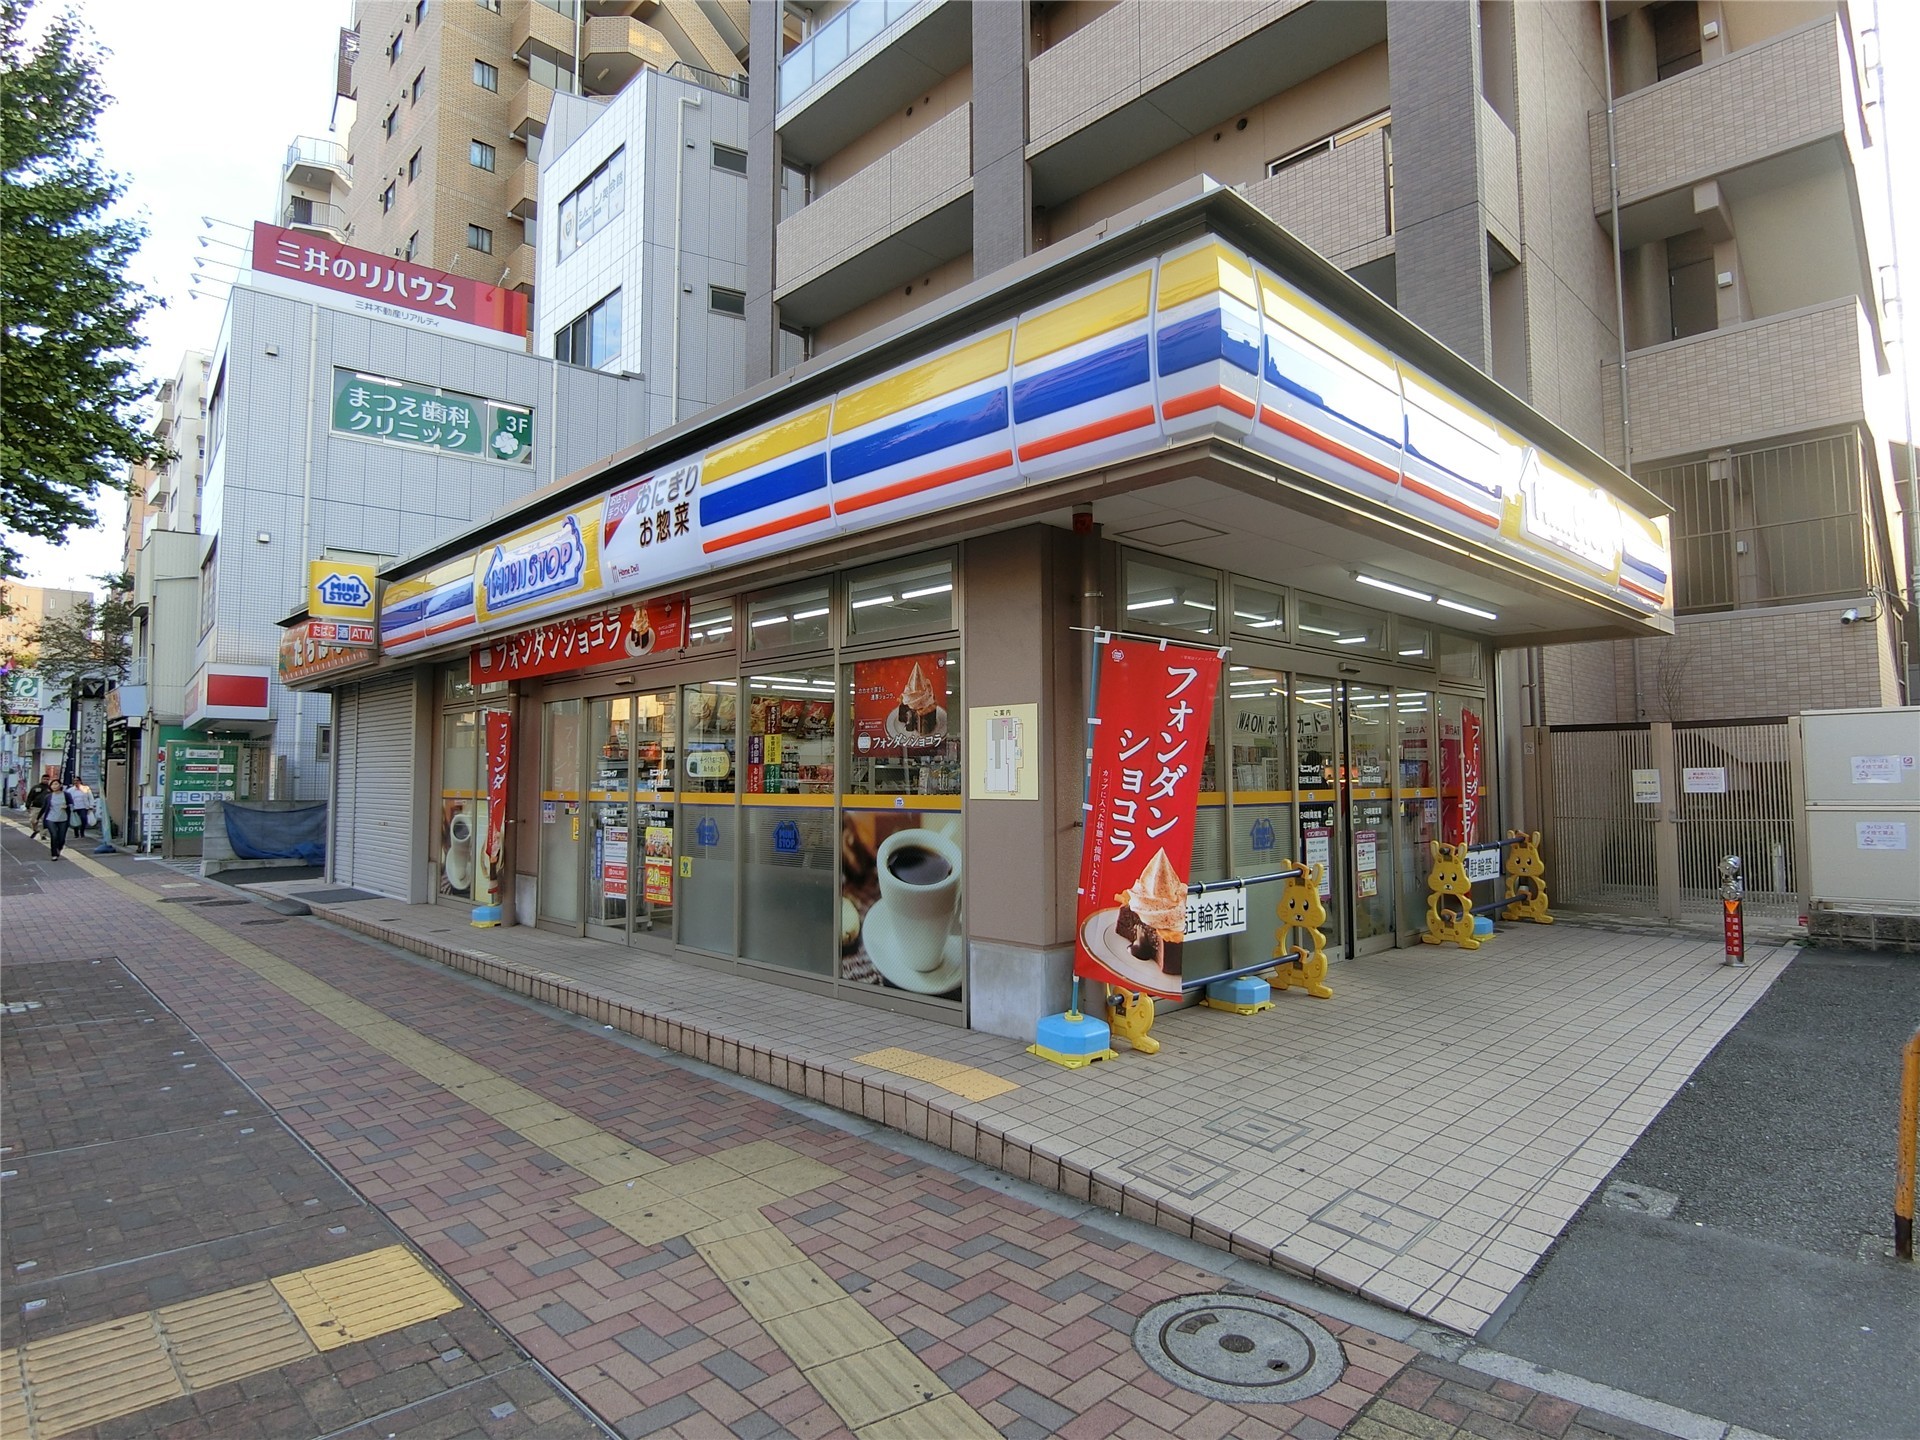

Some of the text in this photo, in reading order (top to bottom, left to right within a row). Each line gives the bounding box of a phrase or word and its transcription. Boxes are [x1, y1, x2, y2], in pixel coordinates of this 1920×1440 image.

[275, 240, 457, 310] 三井のリハウス
[354, 300, 440, 328] 三井不動産リアルティ
[349, 387, 471, 429] まつえ歯科
[350, 410, 467, 448] クリニック
[505, 415, 528, 434] 3F
[636, 465, 698, 515] おにぎり
[639, 501, 690, 548] お惣菜
[492, 541, 573, 599] MINI STOP
[328, 592, 362, 602] STOP
[330, 582, 360, 594] MINI
[312, 625, 336, 637] たばこ
[338, 626, 349, 638] 酒
[351, 628, 373, 640] ATM
[495, 615, 622, 672] フォンダンショコラ
[993, 709, 1012, 717] ご案内
[1238, 711, 1265, 734] WAON
[872, 734, 942, 749] フォンダンショコラ
[1145, 666, 1199, 839] フォンダン
[189, 792, 224, 802] ena
[1109, 729, 1151, 863] ショコラ
[778, 828, 795, 839] MINI
[778, 837, 796, 849] STOP
[1469, 853, 1499, 879] 駐輪禁止
[1184, 898, 1246, 937] 駐輪禁止
